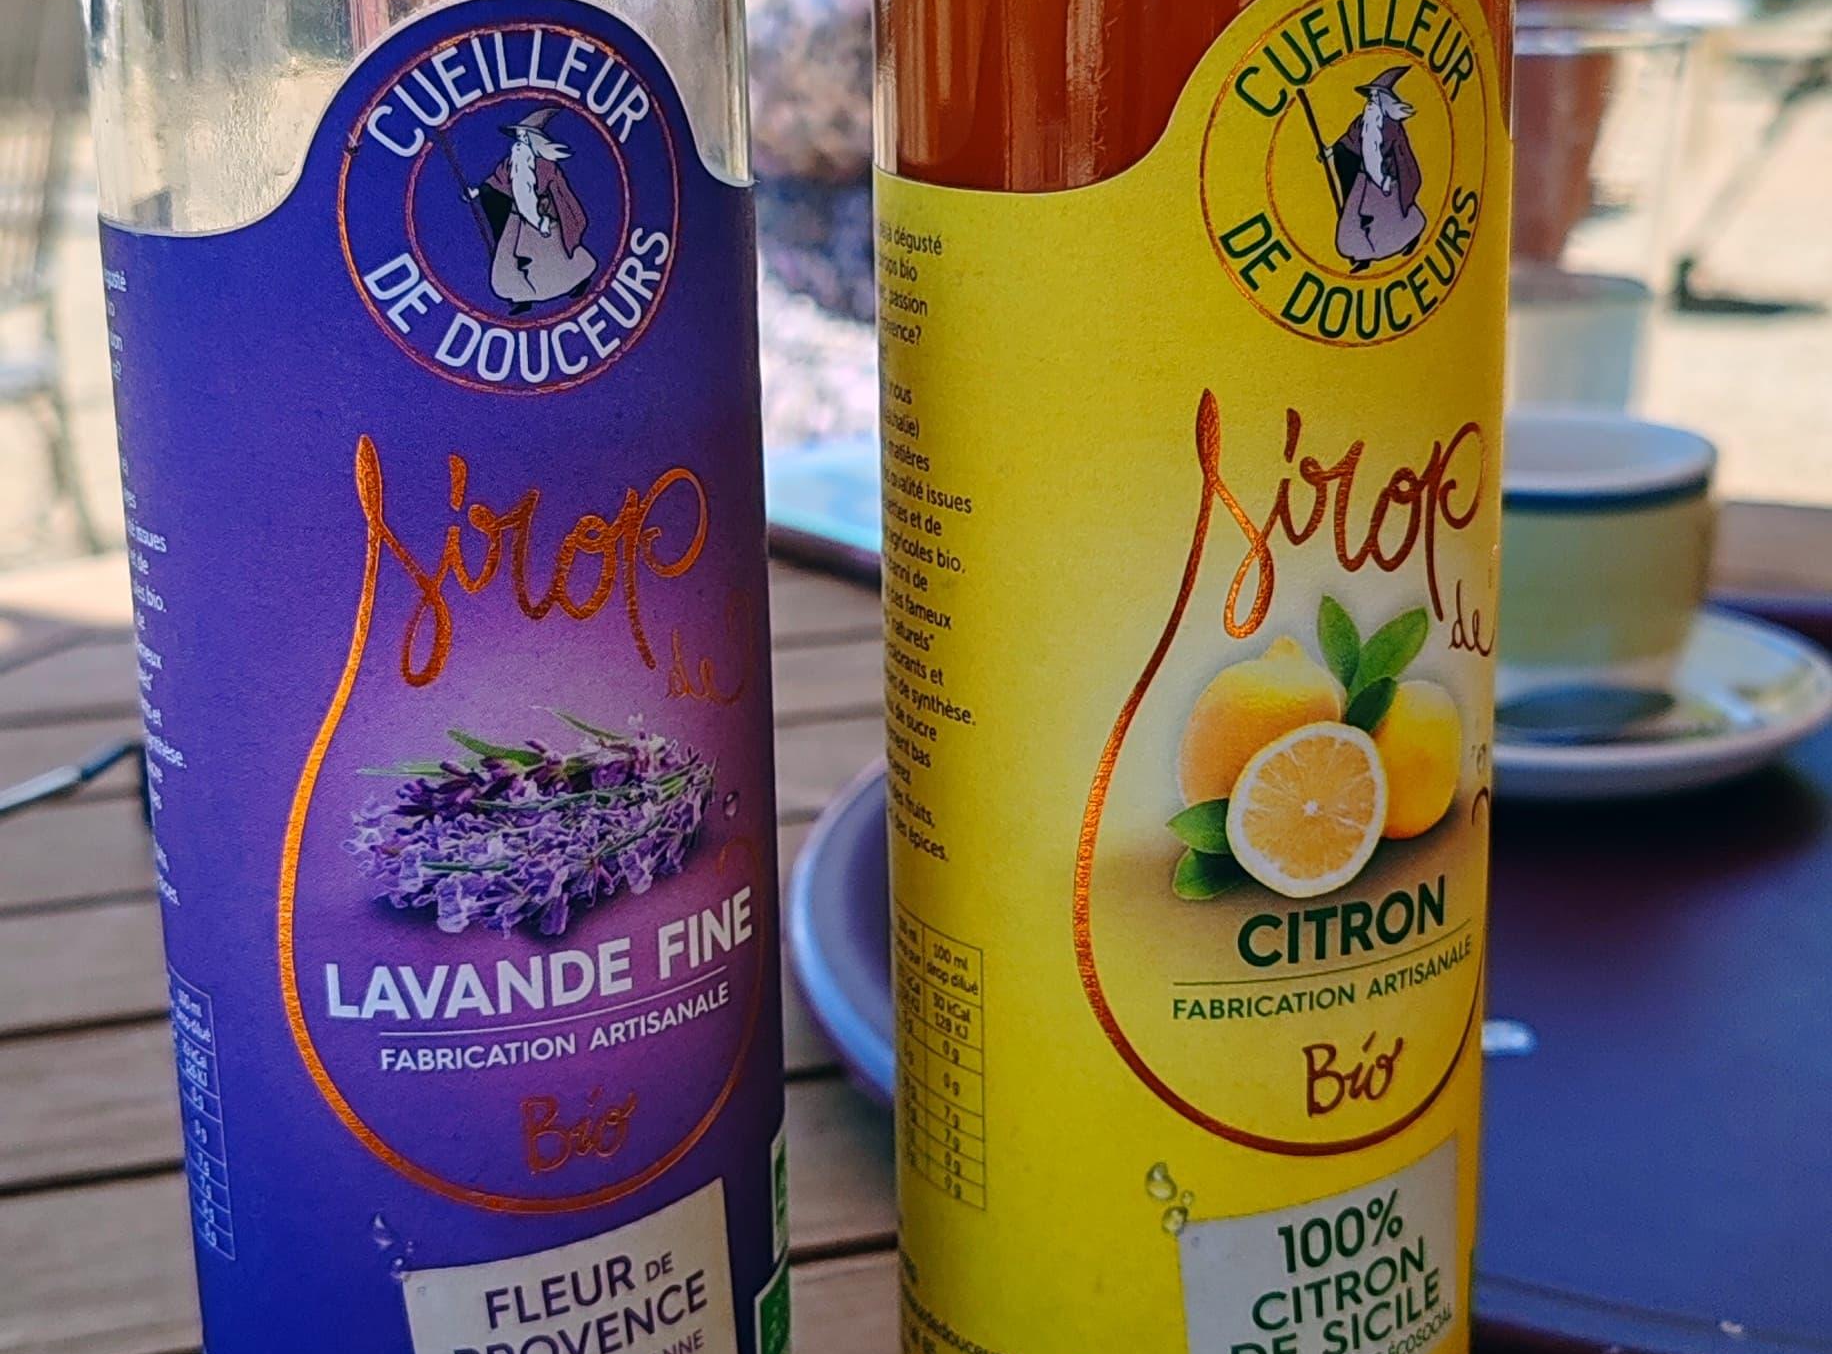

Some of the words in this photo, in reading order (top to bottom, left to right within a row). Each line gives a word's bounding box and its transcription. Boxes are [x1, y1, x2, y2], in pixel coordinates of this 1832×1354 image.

[367, 29, 651, 159] CUEILLEUR
[894, 226, 943, 255] dégusté
[900, 257, 918, 282] bio
[1219, 211, 1296, 293] DE
[1281, 186, 1480, 341] DOUCEURS
[364, 251, 443, 336] DE
[434, 226, 671, 384] DOUCEURS
[910, 514, 922, 531] et
[924, 516, 942, 537] de
[926, 484, 972, 514] issues
[1195, 387, 1488, 639] Sirop
[353, 433, 708, 690] Sirop
[912, 571, 928, 591] de
[905, 594, 952, 630] fameux
[1449, 579, 1496, 657] de
[930, 667, 945, 687] et
[911, 743, 932, 768] bas
[325, 937, 633, 1019] LAVANDE
[657, 887, 753, 974] FINE
[1236, 874, 1446, 969] CITRON
[1172, 985, 1356, 1022] FABRICATION
[1367, 934, 1473, 1002] ARTISANALE
[380, 1034, 577, 1072] FABRICATION
[589, 982, 731, 1052] ARTISANALE
[1302, 1032, 1403, 1119] Bio
[520, 1088, 641, 1176] Bio
[1278, 1188, 1403, 1274] 100%
[483, 1253, 636, 1330] FLEUR
[645, 1251, 675, 1285] DE
[1252, 1236, 1427, 1333] CITRON
